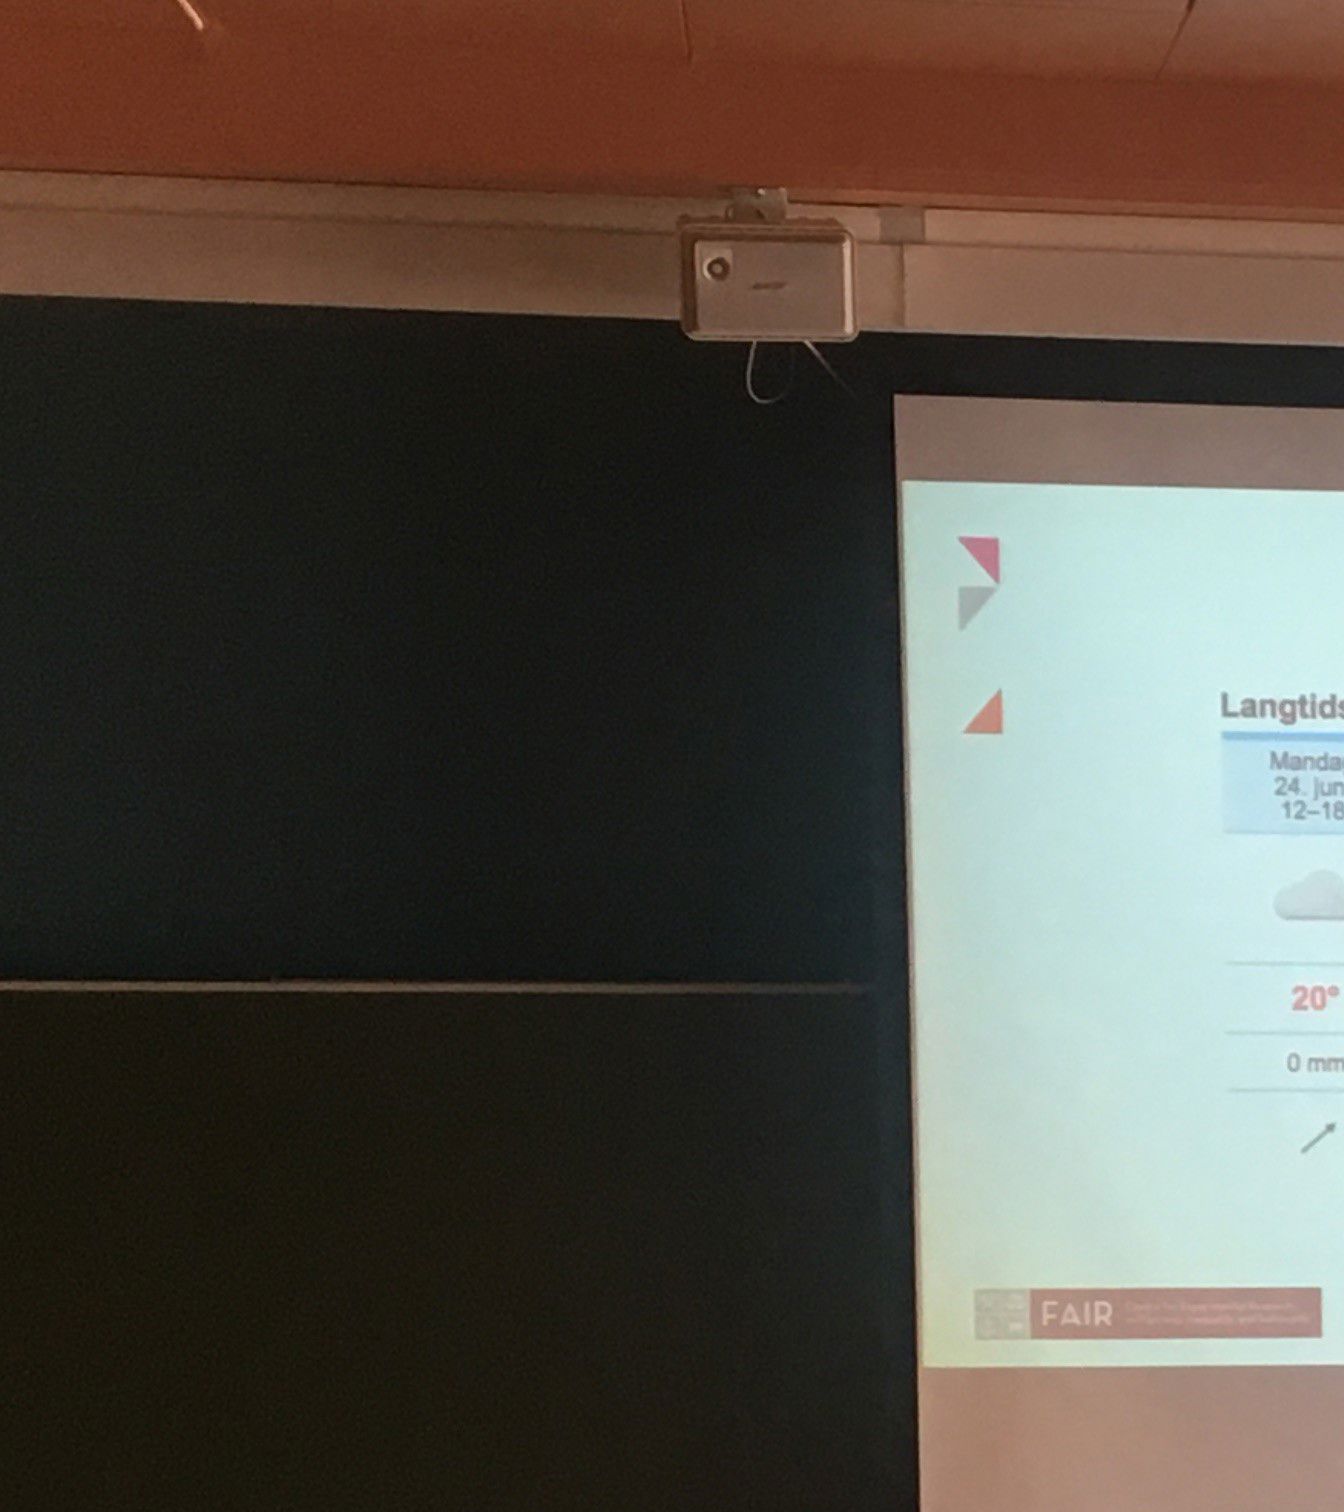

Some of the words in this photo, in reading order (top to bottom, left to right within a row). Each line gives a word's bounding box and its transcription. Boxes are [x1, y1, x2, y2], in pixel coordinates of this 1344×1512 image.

[1274, 777, 1307, 797] 24.
[1286, 1053, 1302, 1073] 0
[1041, 1299, 1113, 1327] FAIR
